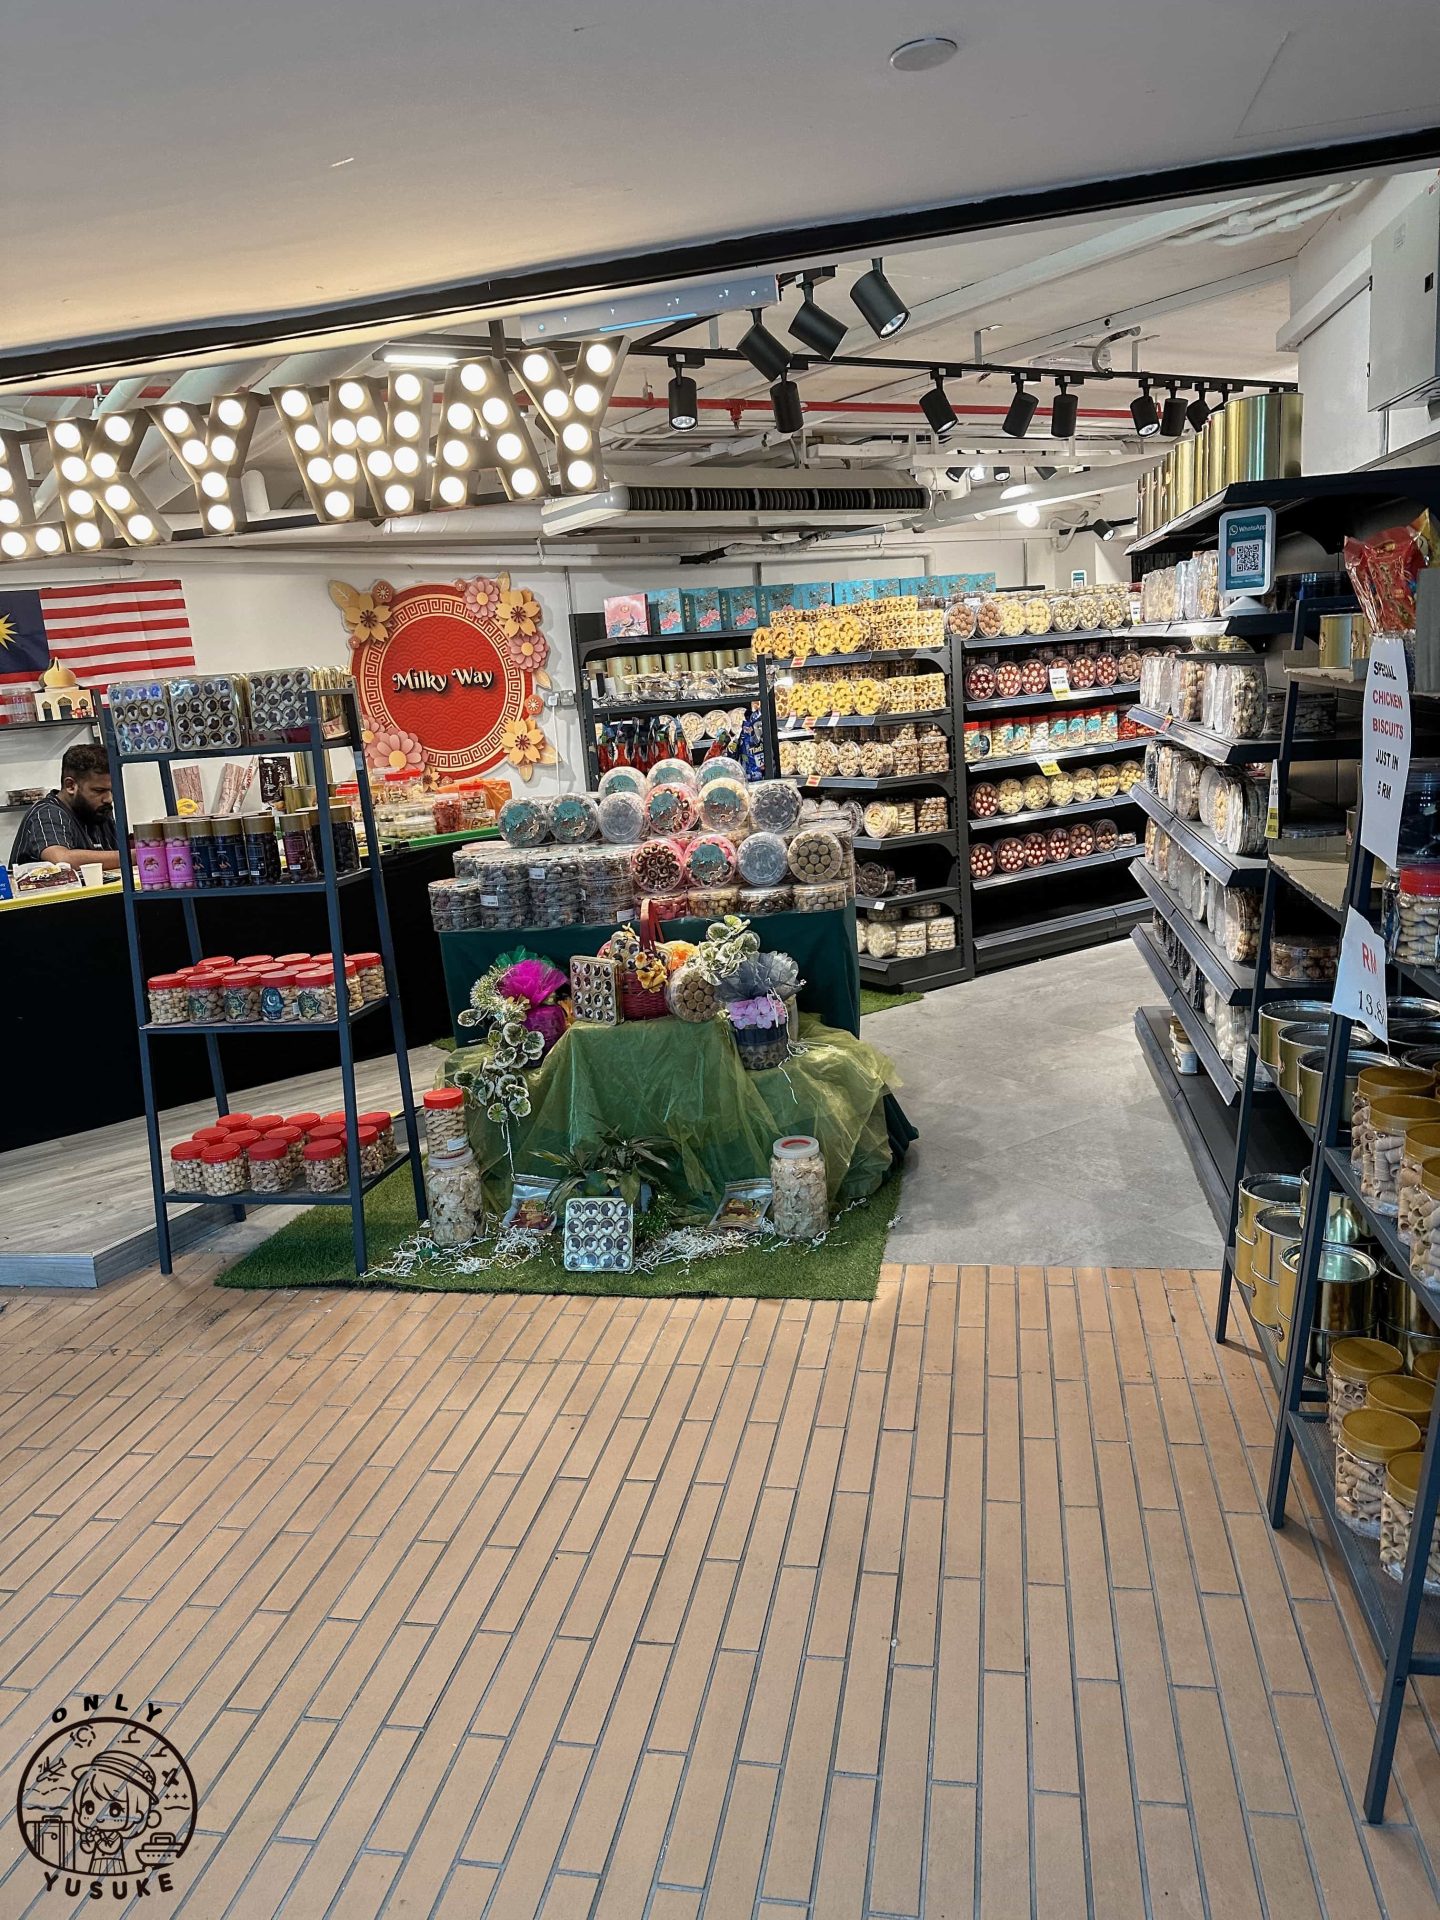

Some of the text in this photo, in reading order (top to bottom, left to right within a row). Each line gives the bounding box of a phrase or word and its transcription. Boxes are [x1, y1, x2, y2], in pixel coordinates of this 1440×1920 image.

[1238, 524, 1266, 533] WhatsApp
[392, 666, 493, 692] Milky Way
[1373, 660, 1397, 681] SPECIAL
[1372, 689, 1403, 710] CHICKEN
[1372, 717, 1404, 741] BISCUITS
[1375, 748, 1399, 772] JUST IN
[1382, 783, 1392, 801] RM
